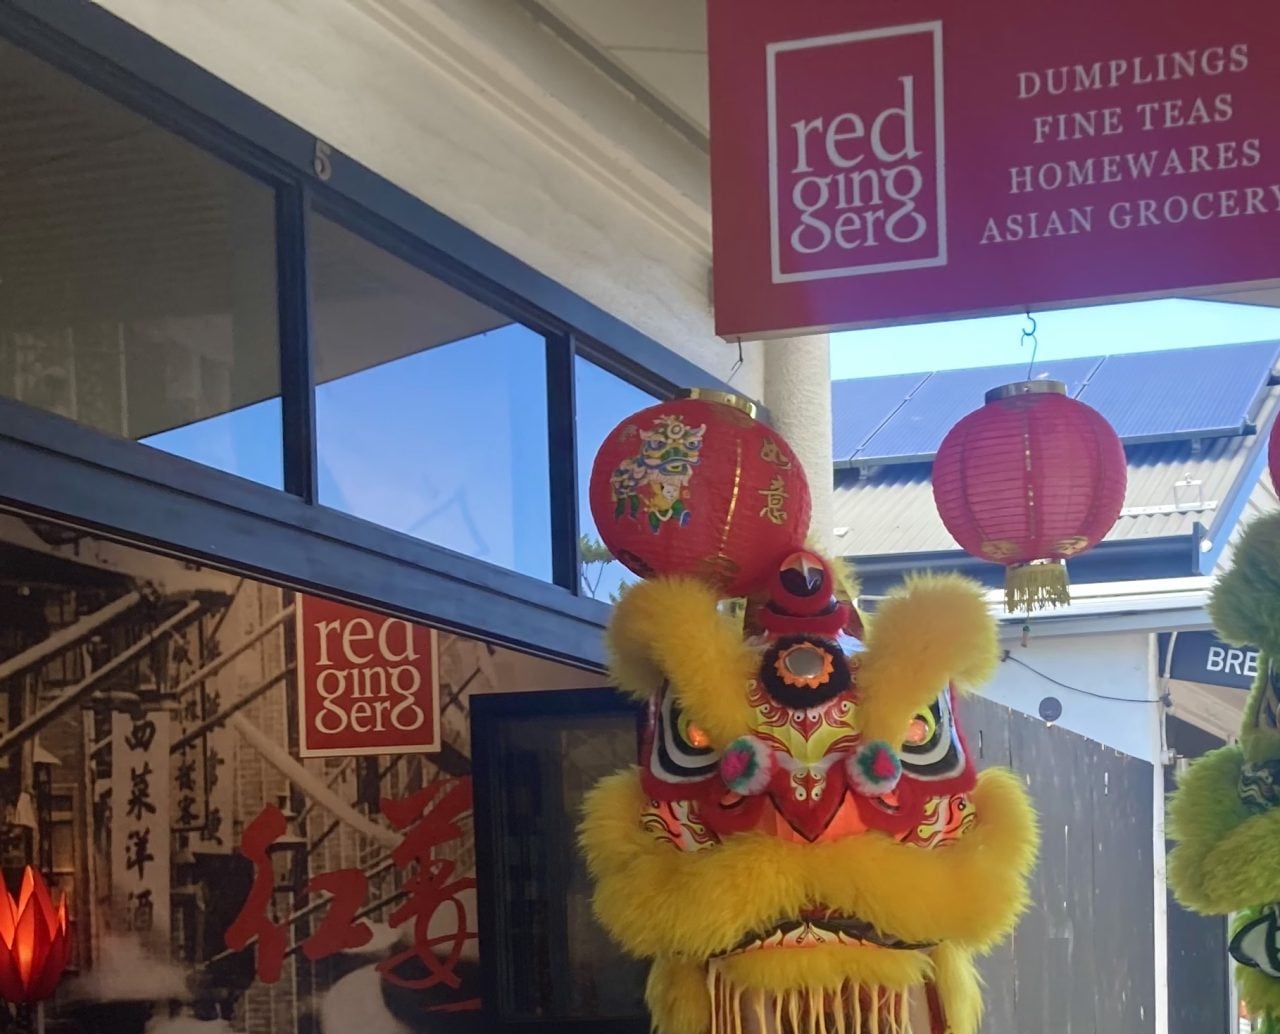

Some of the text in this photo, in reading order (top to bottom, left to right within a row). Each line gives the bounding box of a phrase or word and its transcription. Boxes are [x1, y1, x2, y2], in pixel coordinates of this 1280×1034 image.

[1016, 44, 1249, 99] DUMPLINGS
[790, 75, 923, 173] red
[1032, 94, 1233, 144] FINE TEAS
[1008, 138, 1262, 194] HOMEWARES
[979, 206, 1094, 244] ASIAN
